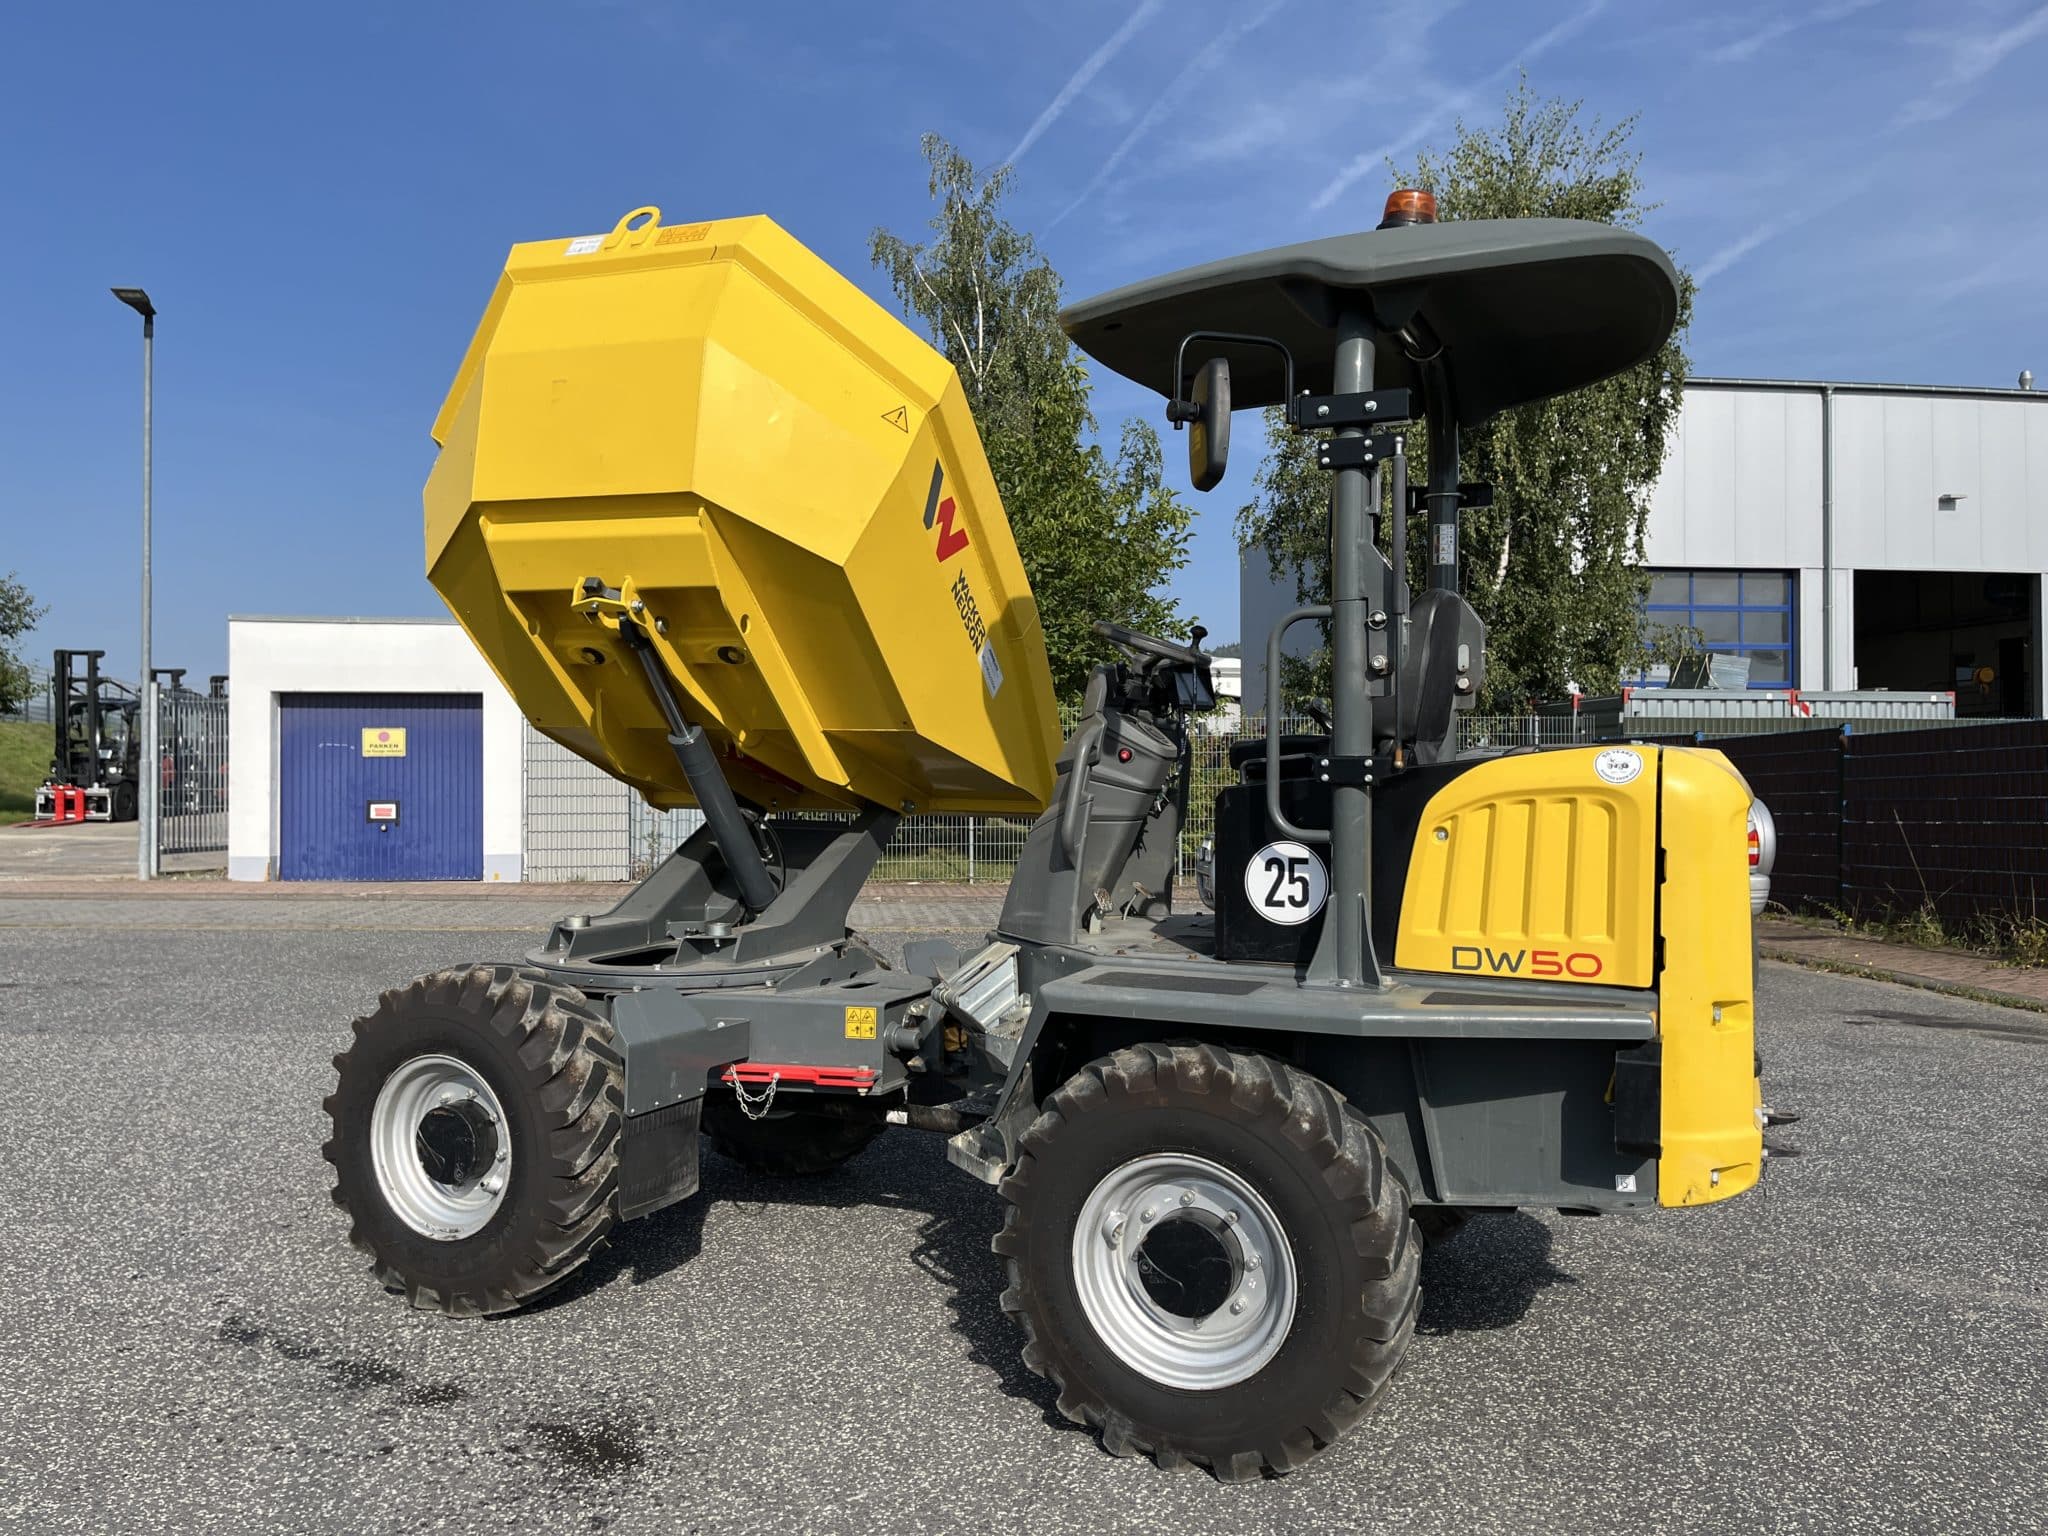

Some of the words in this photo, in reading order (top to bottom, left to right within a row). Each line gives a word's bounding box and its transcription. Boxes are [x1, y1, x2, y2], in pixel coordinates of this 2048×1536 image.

[951, 581, 981, 655] NEUSON
[958, 567, 986, 643] WACKER
[1265, 857, 1309, 908] 25
[1452, 946, 1602, 978] DW50
